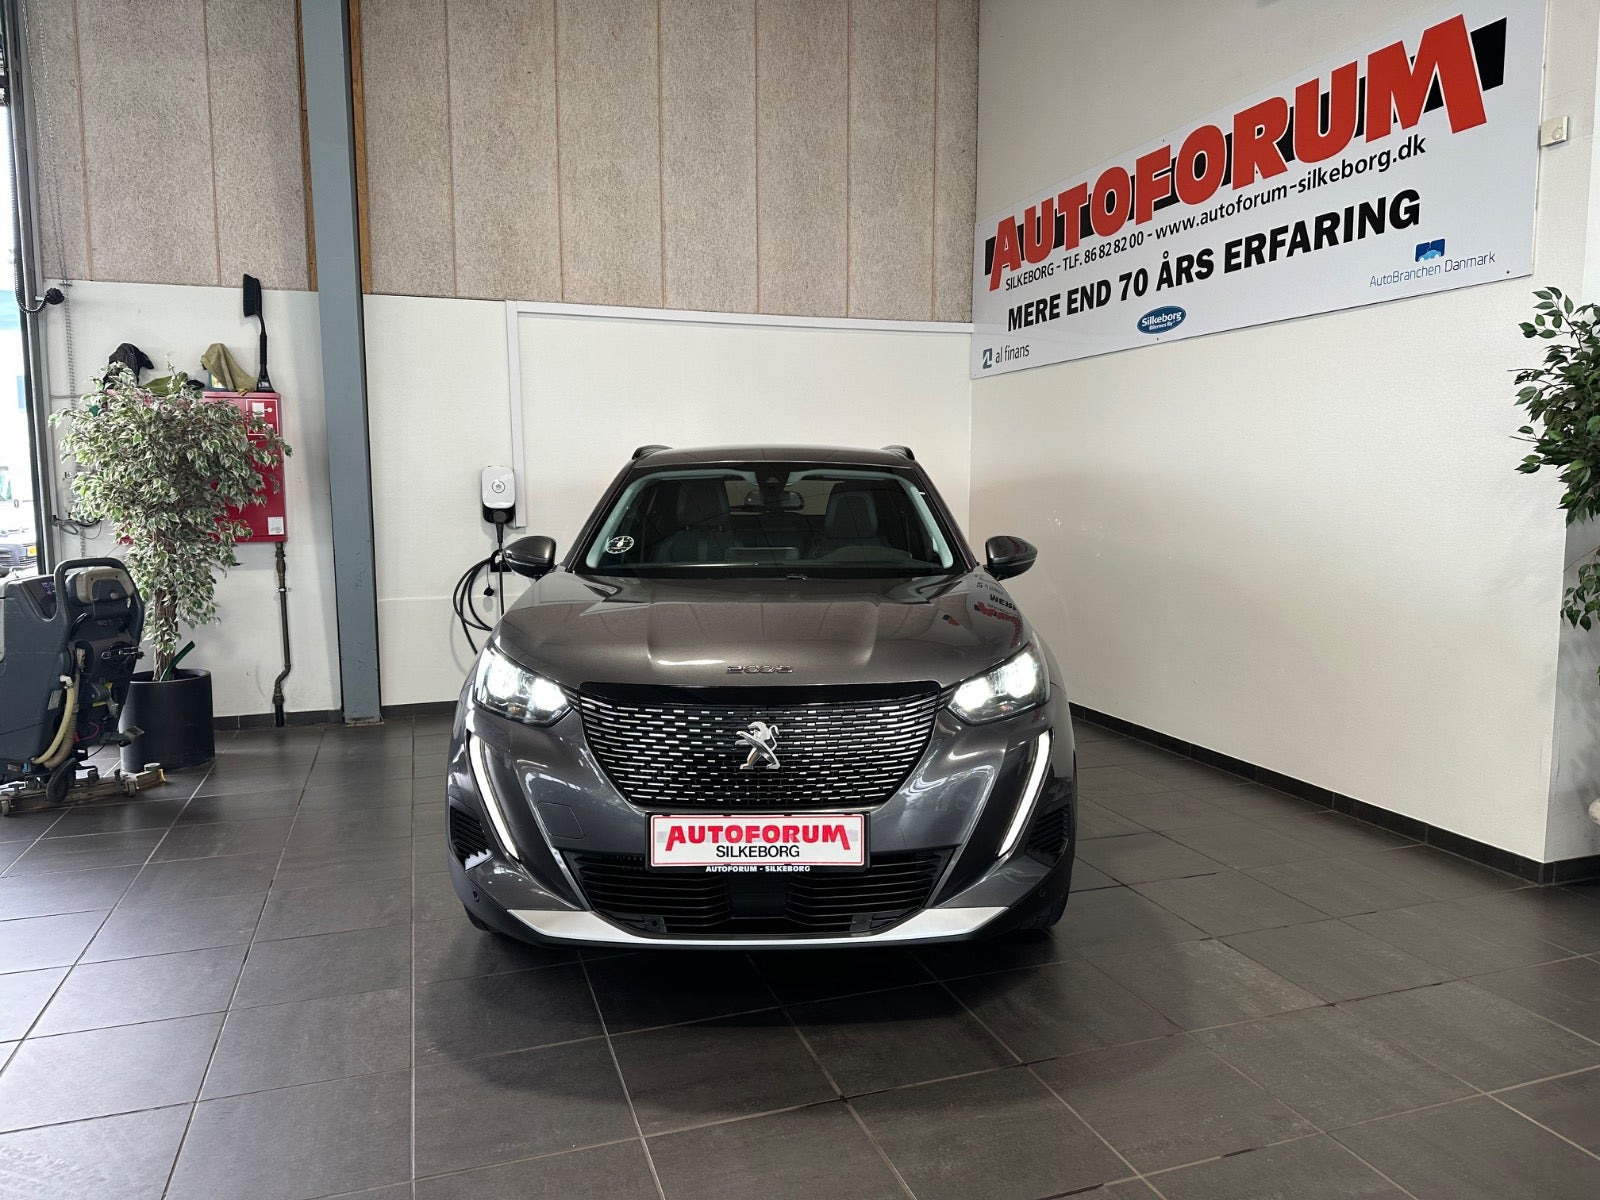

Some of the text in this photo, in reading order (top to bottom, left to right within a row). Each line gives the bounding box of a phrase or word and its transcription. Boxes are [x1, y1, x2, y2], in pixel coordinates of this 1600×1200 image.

[988, 13, 1487, 291] AUTOFORUM
[1005, 262, 1054, 291] SILKEBORG
[1062, 253, 1083, 272] TLF.
[1155, 133, 1426, 240] www.autoforum-silkeborg.dk
[1007, 188, 1421, 332] MERE END 70 ÅRS ERFARING
[1369, 251, 1496, 287] AutoBranchen Danmark
[1141, 311, 1183, 327] Silkeborg
[995, 344, 1030, 363] al finans
[665, 824, 851, 852] AUTOFORUM
[715, 845, 800, 858] SILKEBORG
[705, 865, 758, 873] AUTOFORUM
[764, 865, 811, 873] SILKEBORG
